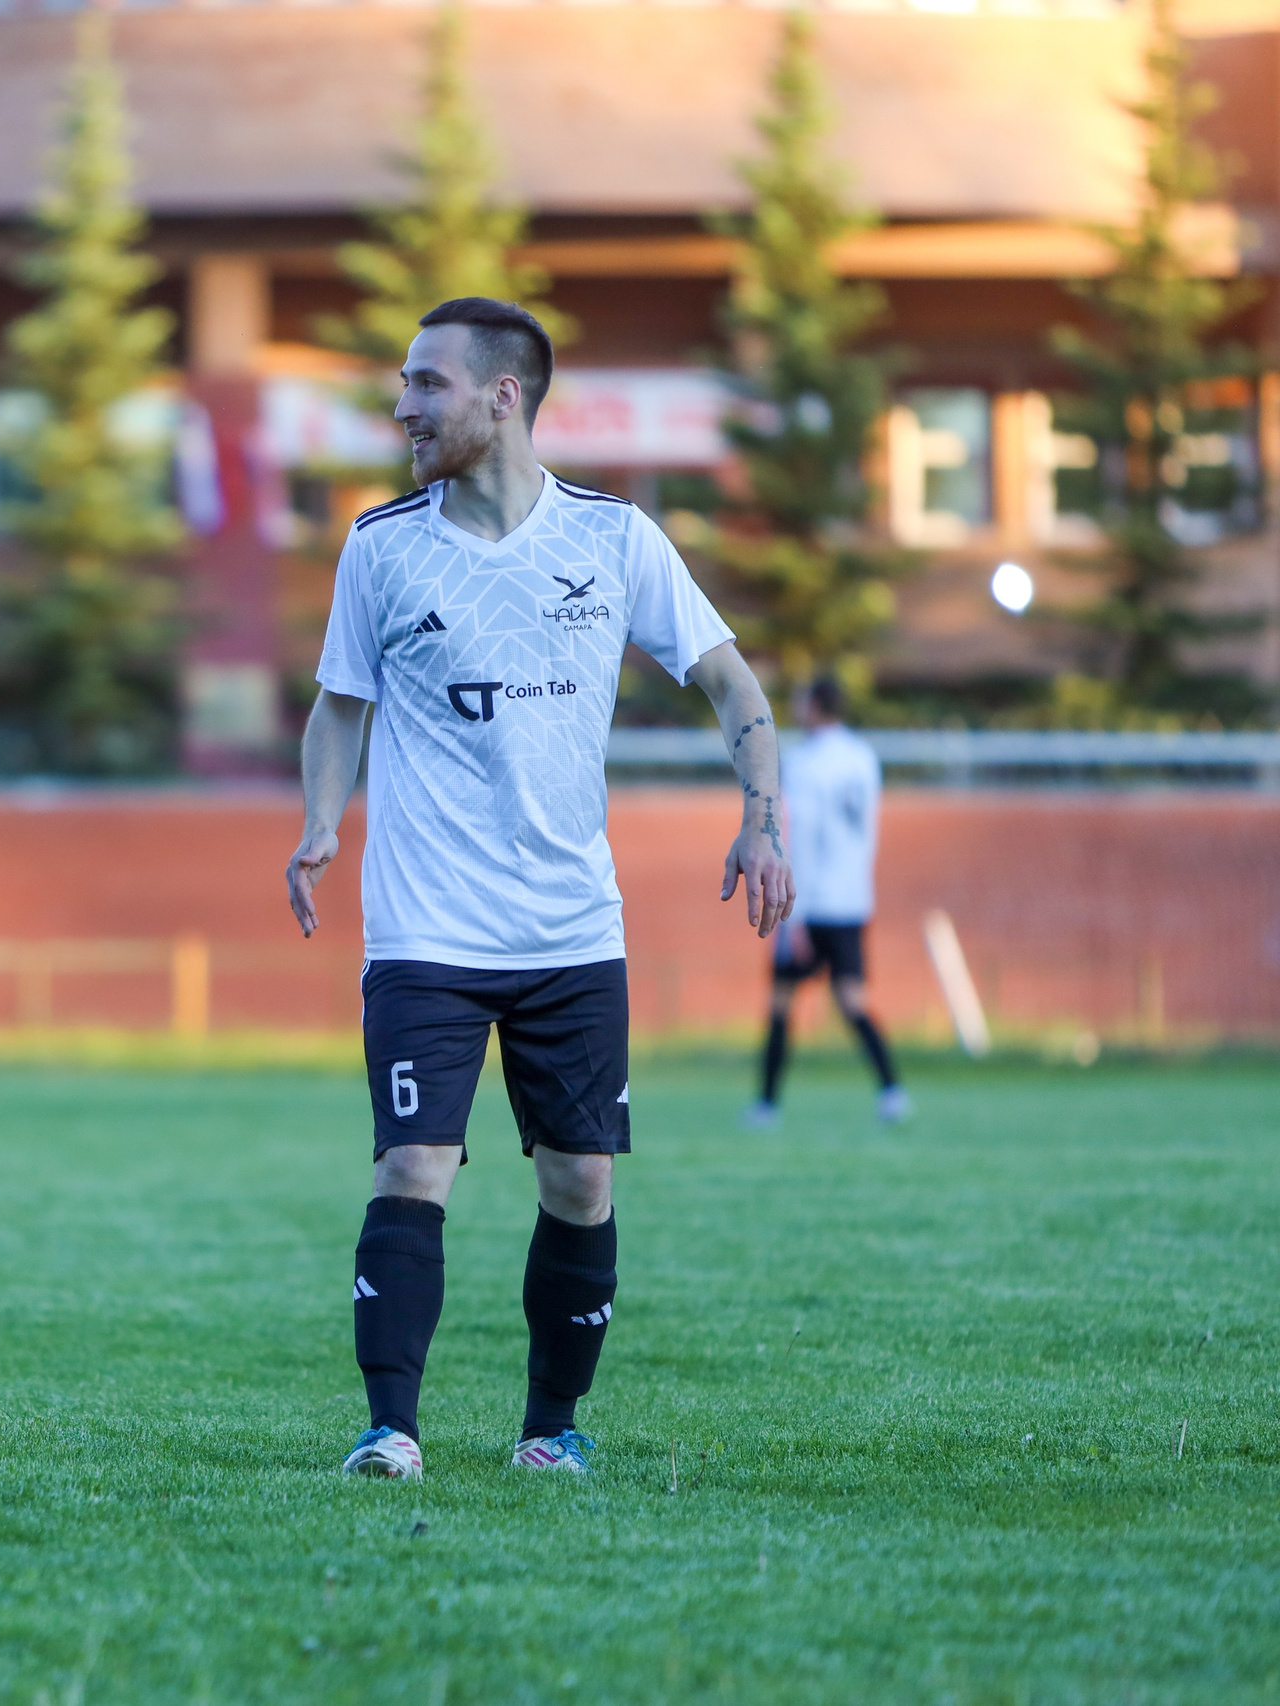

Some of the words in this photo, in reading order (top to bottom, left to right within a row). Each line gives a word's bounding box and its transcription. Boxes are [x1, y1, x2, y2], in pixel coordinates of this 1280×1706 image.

[543, 604, 609, 622] ЧАЙКА
[505, 683, 543, 698] Coin
[547, 680, 577, 695] Tab
[391, 1061, 419, 1117] 6
